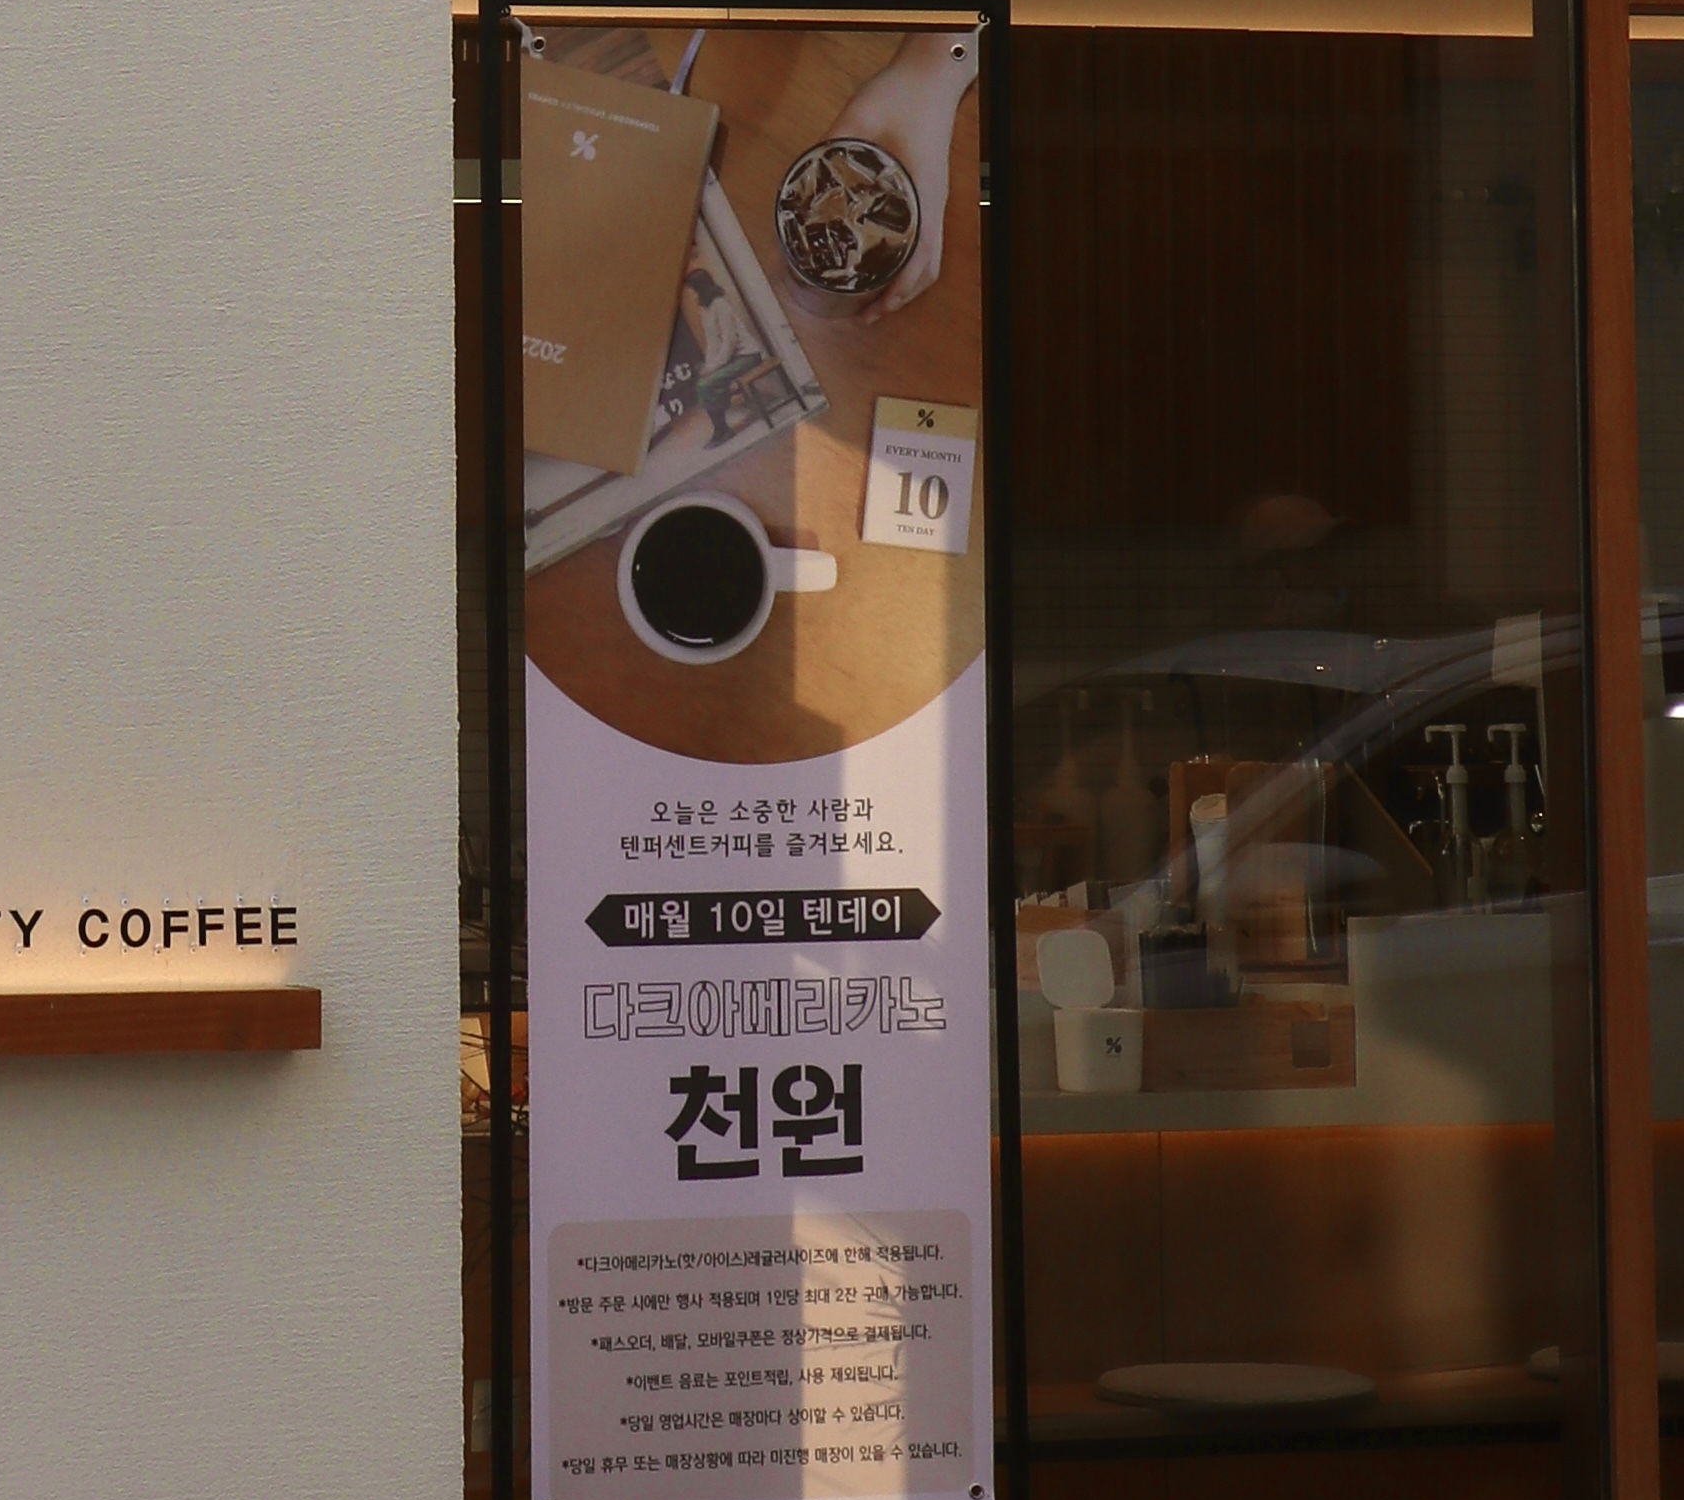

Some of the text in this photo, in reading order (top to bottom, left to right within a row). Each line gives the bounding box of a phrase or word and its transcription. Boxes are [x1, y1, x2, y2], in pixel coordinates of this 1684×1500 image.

[885, 444, 963, 464] EVERY MONTH
[894, 471, 949, 520] 10
[896, 524, 935, 537] TEN DAY
[650, 797, 874, 825] 오늘은 소중한 사람과
[620, 831, 904, 860] 텐퍼센트커피를 즐겨보세요.
[78, 906, 298, 949] COFFEE
[624, 895, 903, 939] 매월 10일 텐데이
[583, 976, 946, 1041] 다크아메리카노
[664, 1063, 864, 1182] 천원
[844, 1246, 871, 1265] 한해
[876, 1244, 944, 1262] 적용됩니다.
[598, 1295, 626, 1313] 주문
[631, 1293, 670, 1311] 시에만
[676, 1292, 703, 1310] 행사
[709, 1290, 761, 1308] 적용되며
[766, 1290, 799, 1306] 1인당
[804, 1288, 830, 1304] 최대
[835, 1287, 857, 1303] 2잔
[863, 1285, 889, 1302] 구매
[894, 1283, 963, 1301] 가능합니다.
[660, 1333, 692, 1351] 배달,
[697, 1330, 776, 1349] 모바일쿠폰은
[781, 1326, 859, 1346] 정상가격으로
[864, 1323, 932, 1342] 결제됩니다.
[678, 1372, 719, 1389] 음료는
[724, 1369, 793, 1387] 포인트적립,
[799, 1367, 824, 1384] 사용
[830, 1364, 898, 1383] 제외됩니다.
[659, 1411, 724, 1431] 영업시간은
[728, 1409, 782, 1428] 매장마다
[788, 1407, 827, 1425] 상이할
[832, 1407, 845, 1422] 수
[850, 1404, 905, 1422] 있습니다.
[601, 1456, 629, 1474] 휴무
[634, 1454, 660, 1472] 또는
[665, 1451, 733, 1470] 매장상황에
[738, 1449, 766, 1467] 따라
[770, 1447, 809, 1465] 미진행
[814, 1446, 854, 1464] 매장이
[859, 1444, 885, 1462] 있을
[890, 1444, 904, 1459] 수
[908, 1441, 962, 1459] 있습니다.
